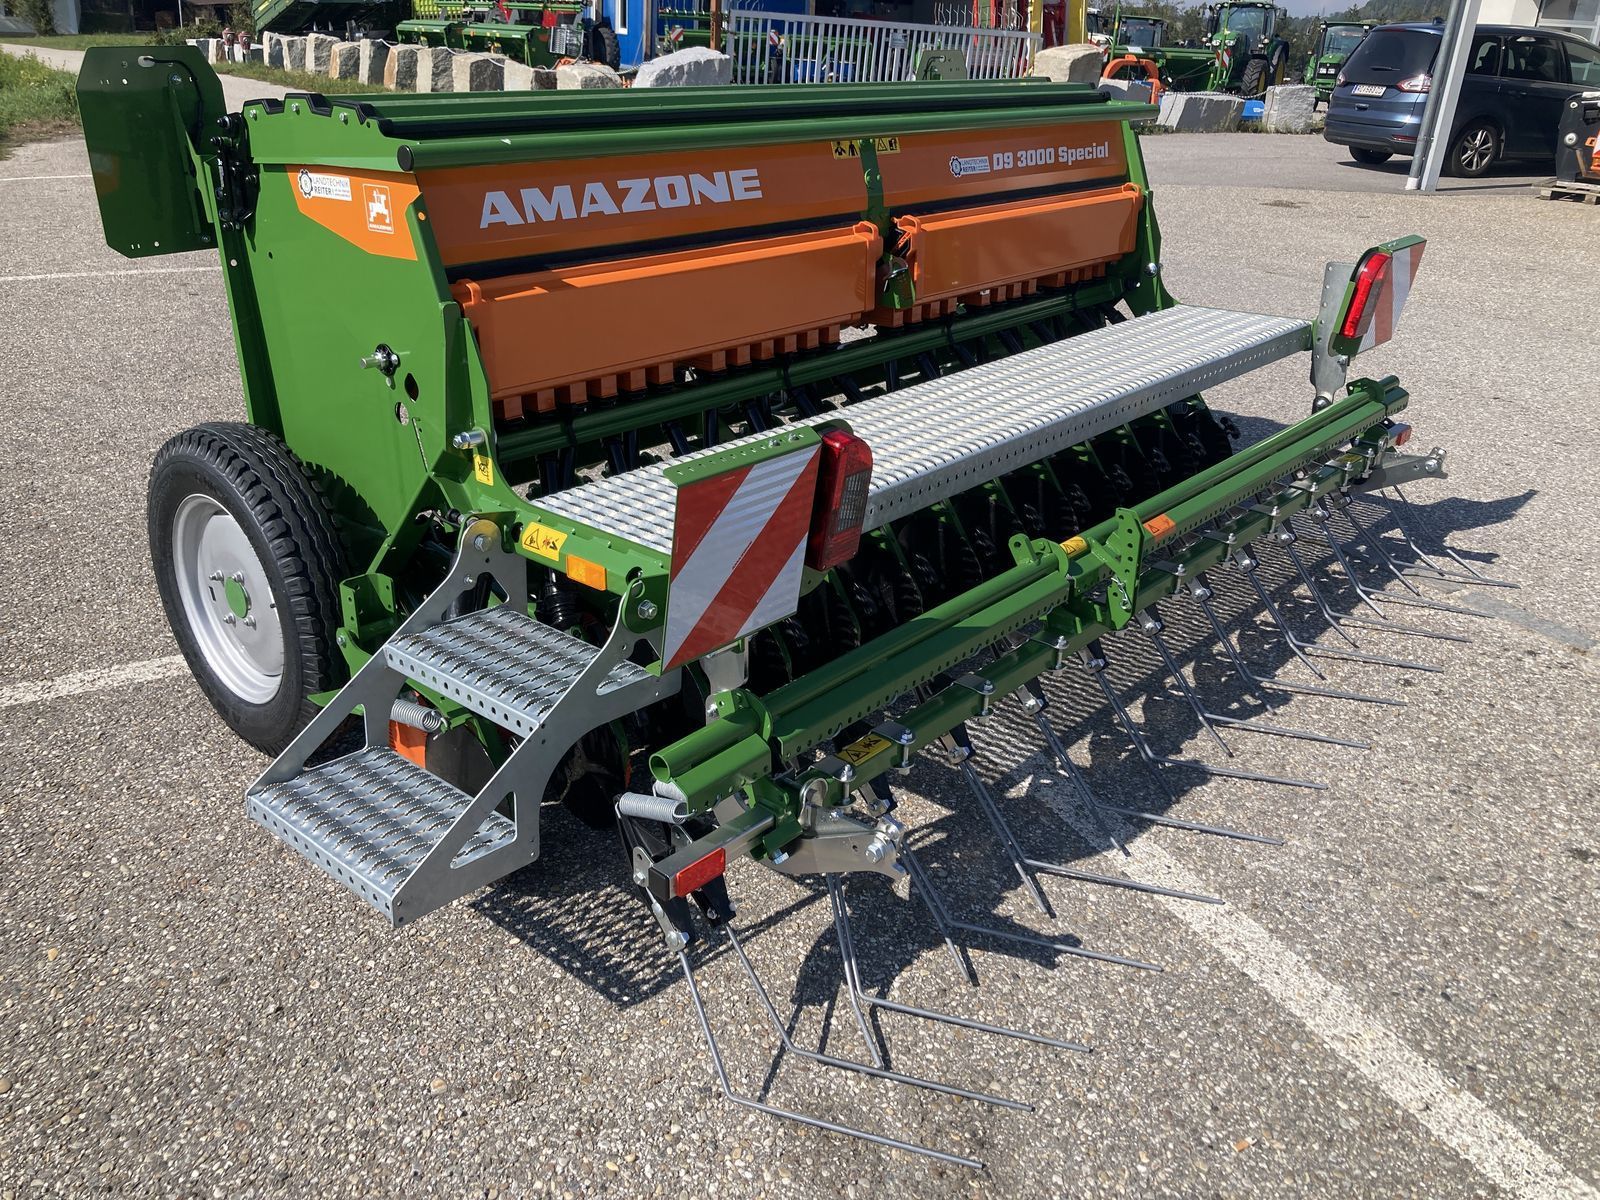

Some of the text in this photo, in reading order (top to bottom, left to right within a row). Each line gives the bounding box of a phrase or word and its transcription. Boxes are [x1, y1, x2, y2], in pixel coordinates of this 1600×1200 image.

[992, 141, 1109, 171] D9 3000 Special
[314, 185, 332, 195] REITER
[479, 168, 763, 229] AMAZONE
